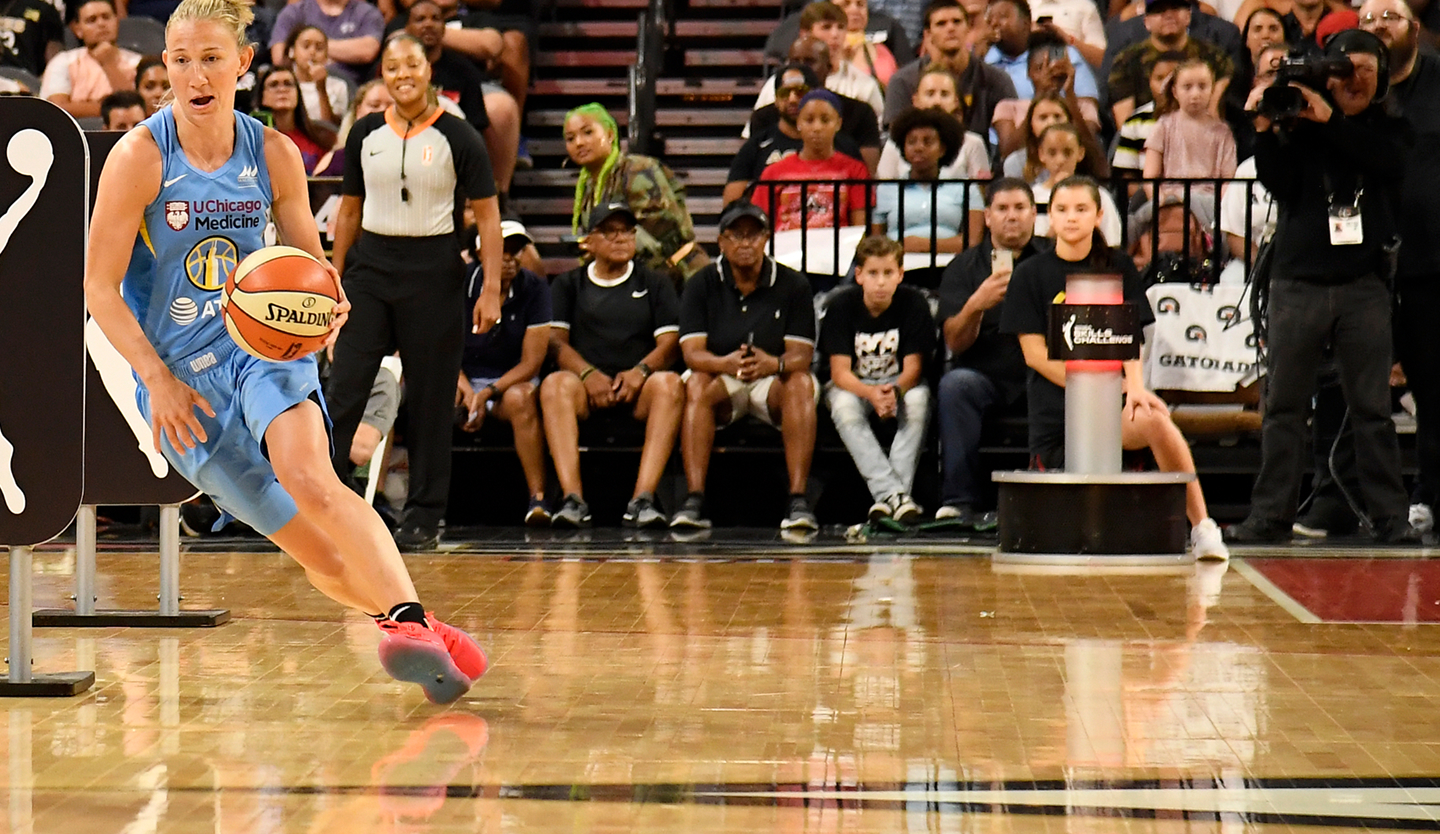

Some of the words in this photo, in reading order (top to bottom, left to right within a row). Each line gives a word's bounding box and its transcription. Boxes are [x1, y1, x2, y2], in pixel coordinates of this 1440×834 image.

[193, 200, 262, 213] UChicago
[195, 215, 259, 231] Medicine
[1074, 329, 1113, 338] SKILLS
[1074, 335, 1134, 345] CHALLENGE
